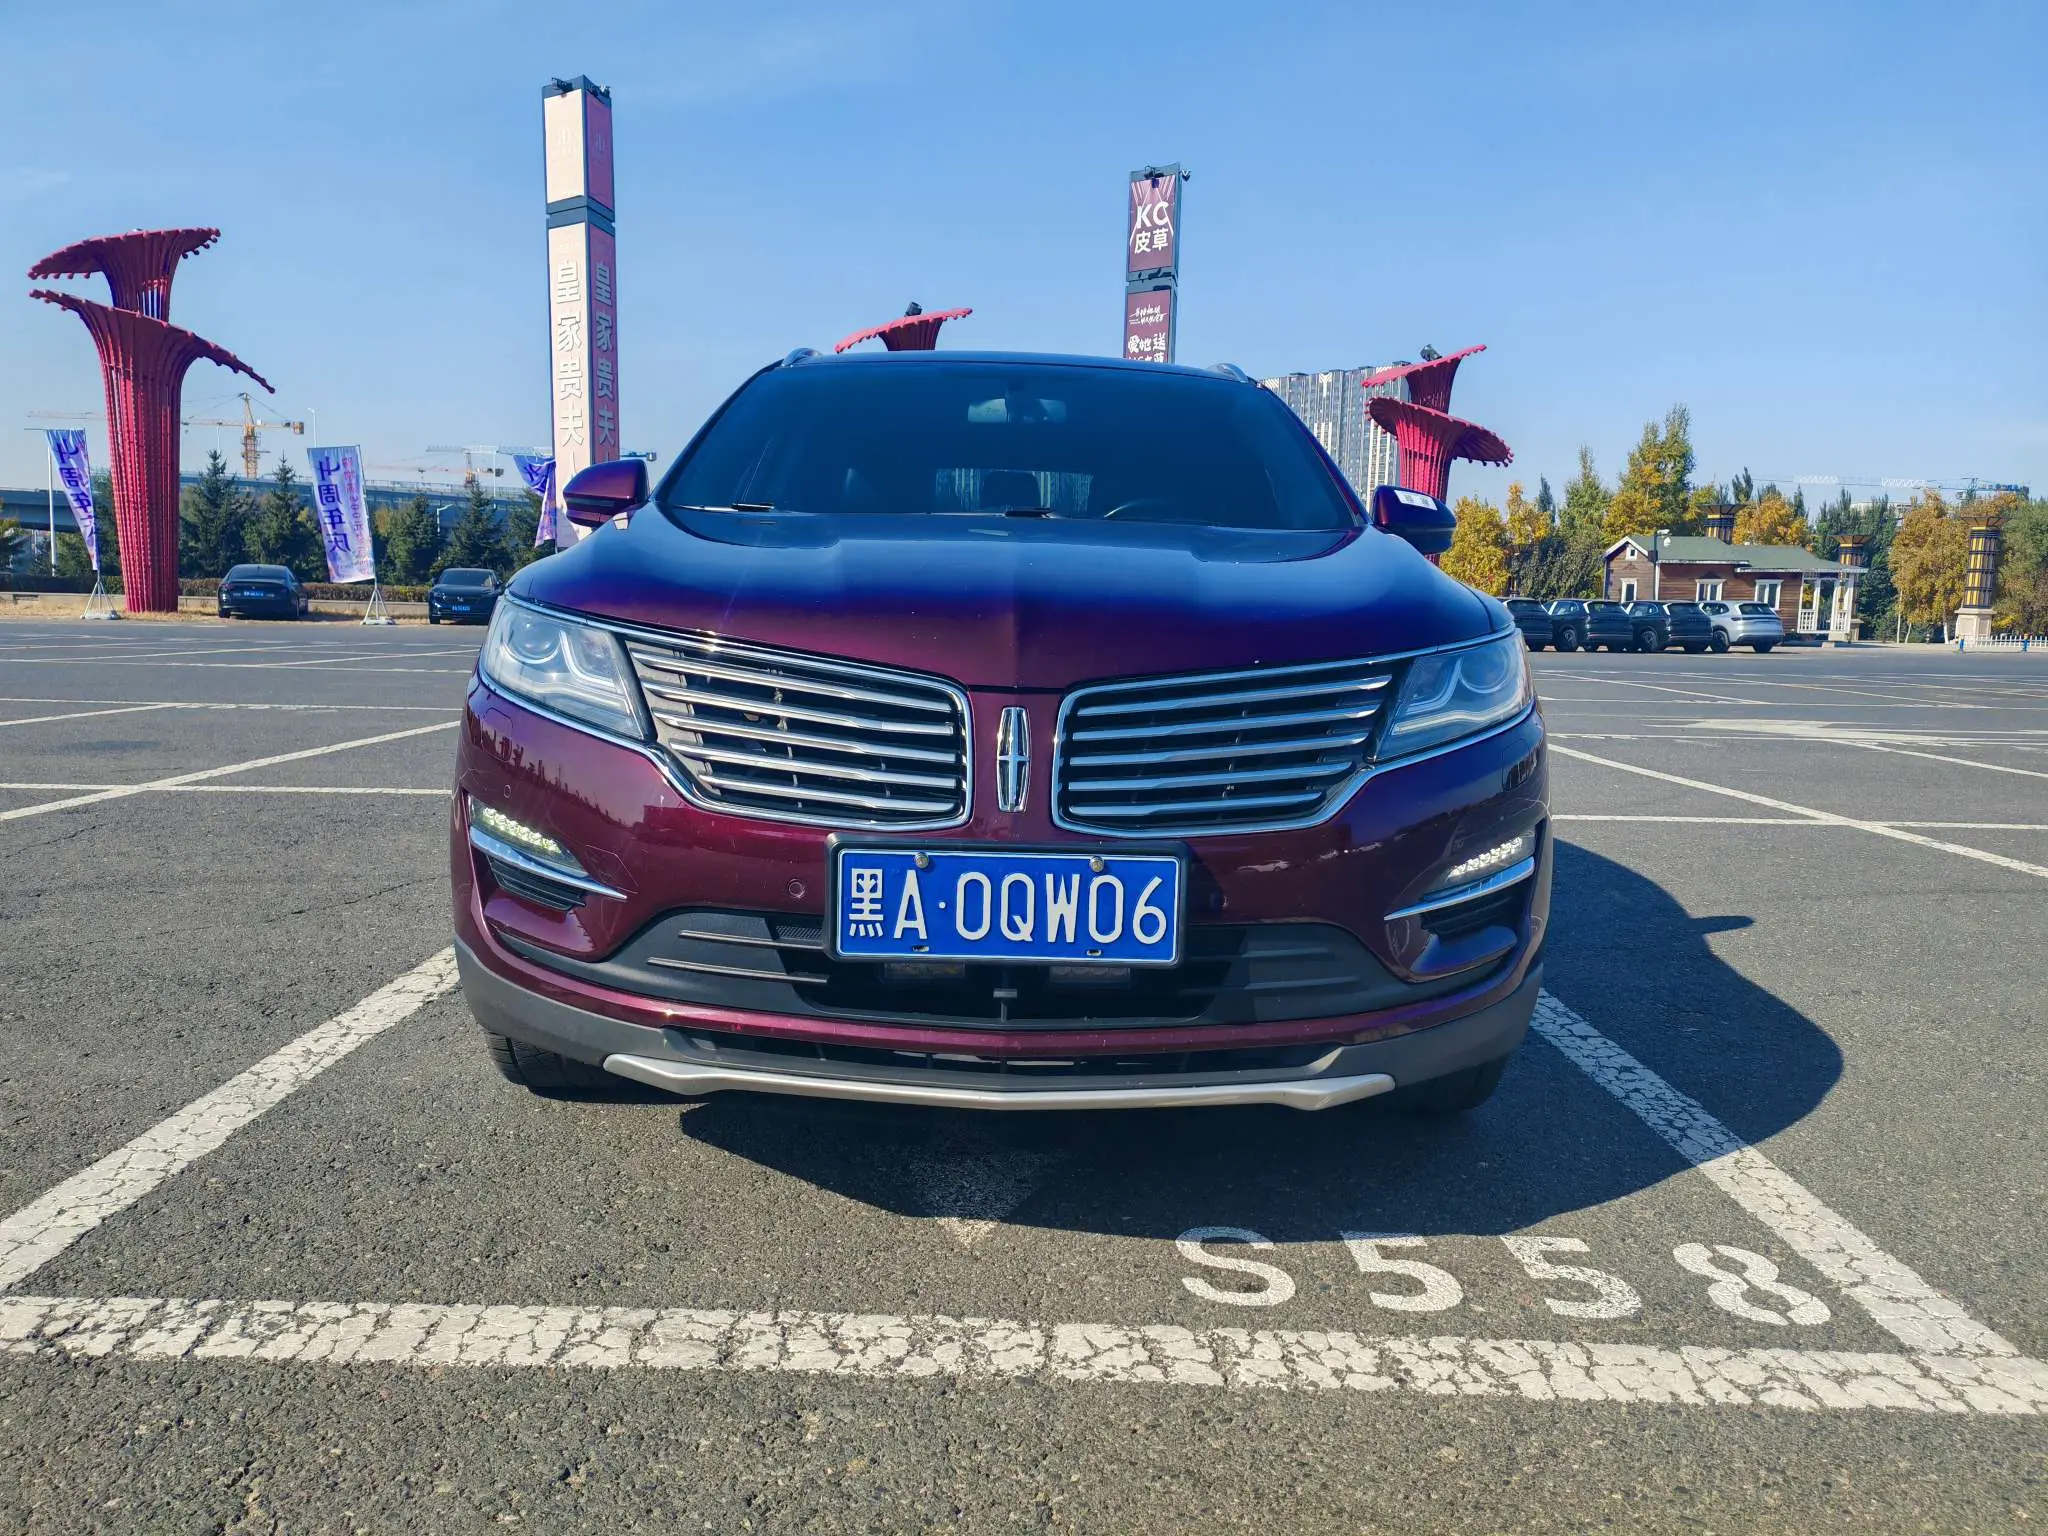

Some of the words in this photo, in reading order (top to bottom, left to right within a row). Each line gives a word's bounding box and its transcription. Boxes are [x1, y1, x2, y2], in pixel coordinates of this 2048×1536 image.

[1136, 201, 1169, 229] KC
[1134, 227, 1169, 254] 皮草
[595, 261, 616, 462] 皇家贵夫
